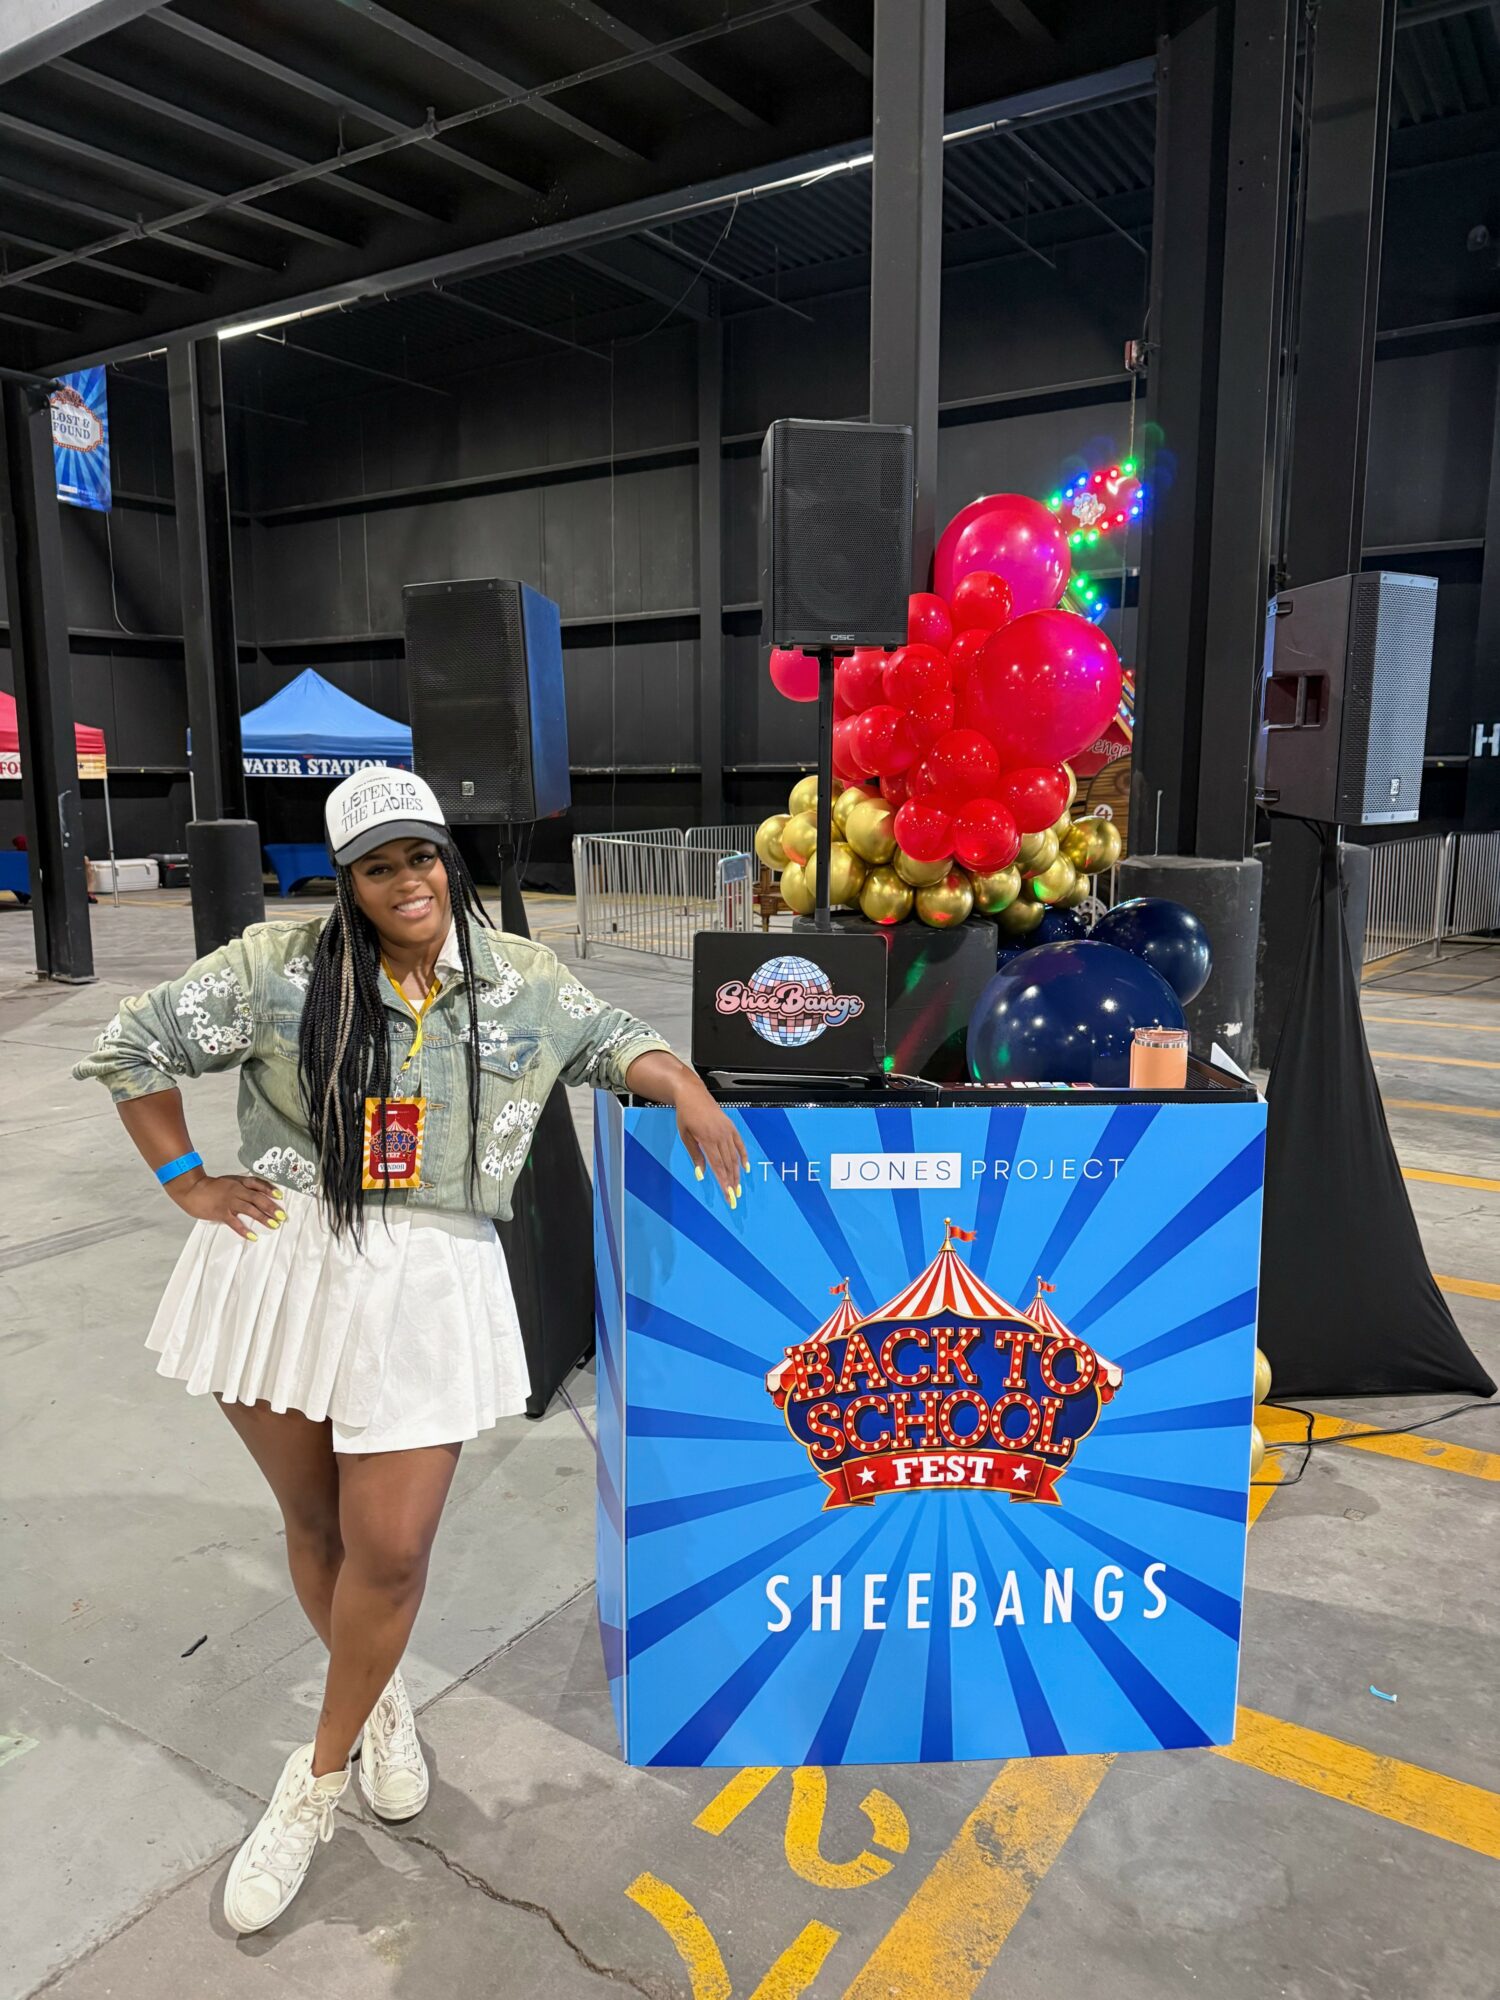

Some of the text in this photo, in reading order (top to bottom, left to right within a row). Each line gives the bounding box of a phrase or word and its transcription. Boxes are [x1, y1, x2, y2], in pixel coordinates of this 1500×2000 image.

[52, 410, 90, 429] LOST &
[53, 421, 91, 440] FOUND
[341, 796, 424, 834] THE LADIES
[342, 782, 393, 815] LISTEN
[395, 782, 416, 796] TO
[716, 981, 864, 1026] SheeBangs
[757, 1157, 1125, 1182] THE JONES PROJECT
[784, 1327, 1096, 1402] BACK TO
[806, 1389, 1072, 1459] SCHOOL
[892, 1455, 994, 1486] FEST
[765, 1562, 1168, 1633] SHEEBANGS
